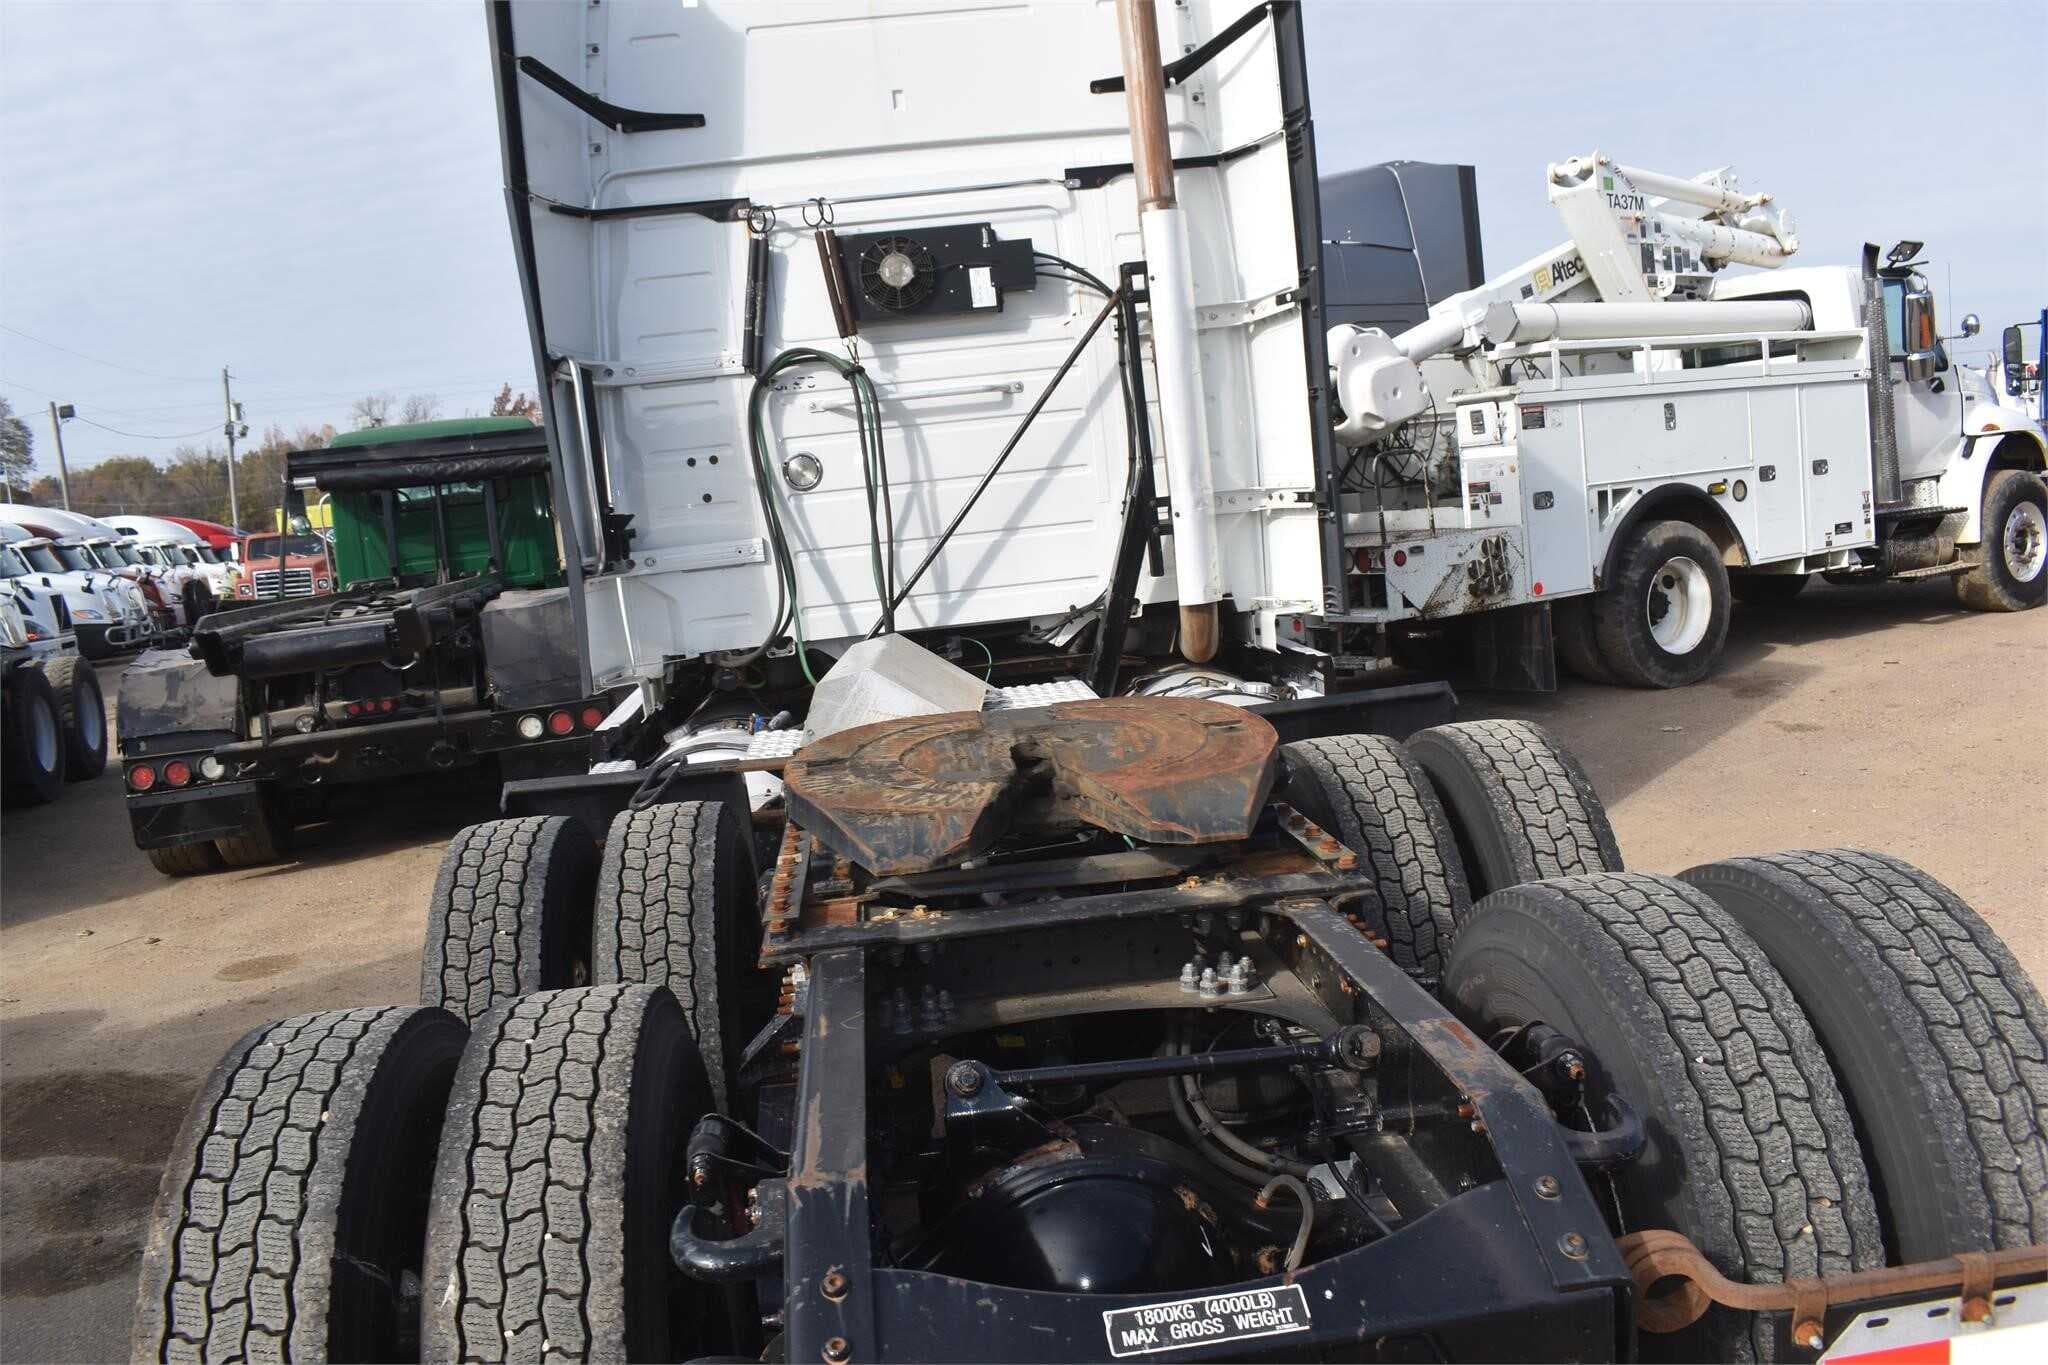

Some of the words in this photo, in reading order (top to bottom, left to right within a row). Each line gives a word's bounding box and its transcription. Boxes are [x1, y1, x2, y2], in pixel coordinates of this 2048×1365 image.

[1606, 193, 1645, 211] TA37M
[1552, 256, 1584, 286] Altec
[1134, 1304, 1196, 1327] 1800KG
[1204, 1291, 1277, 1318] (4000LB)
[1121, 1327, 1159, 1347] MAX
[1169, 1318, 1225, 1340] GROSS
[1232, 1307, 1295, 1330] WEIGHT
